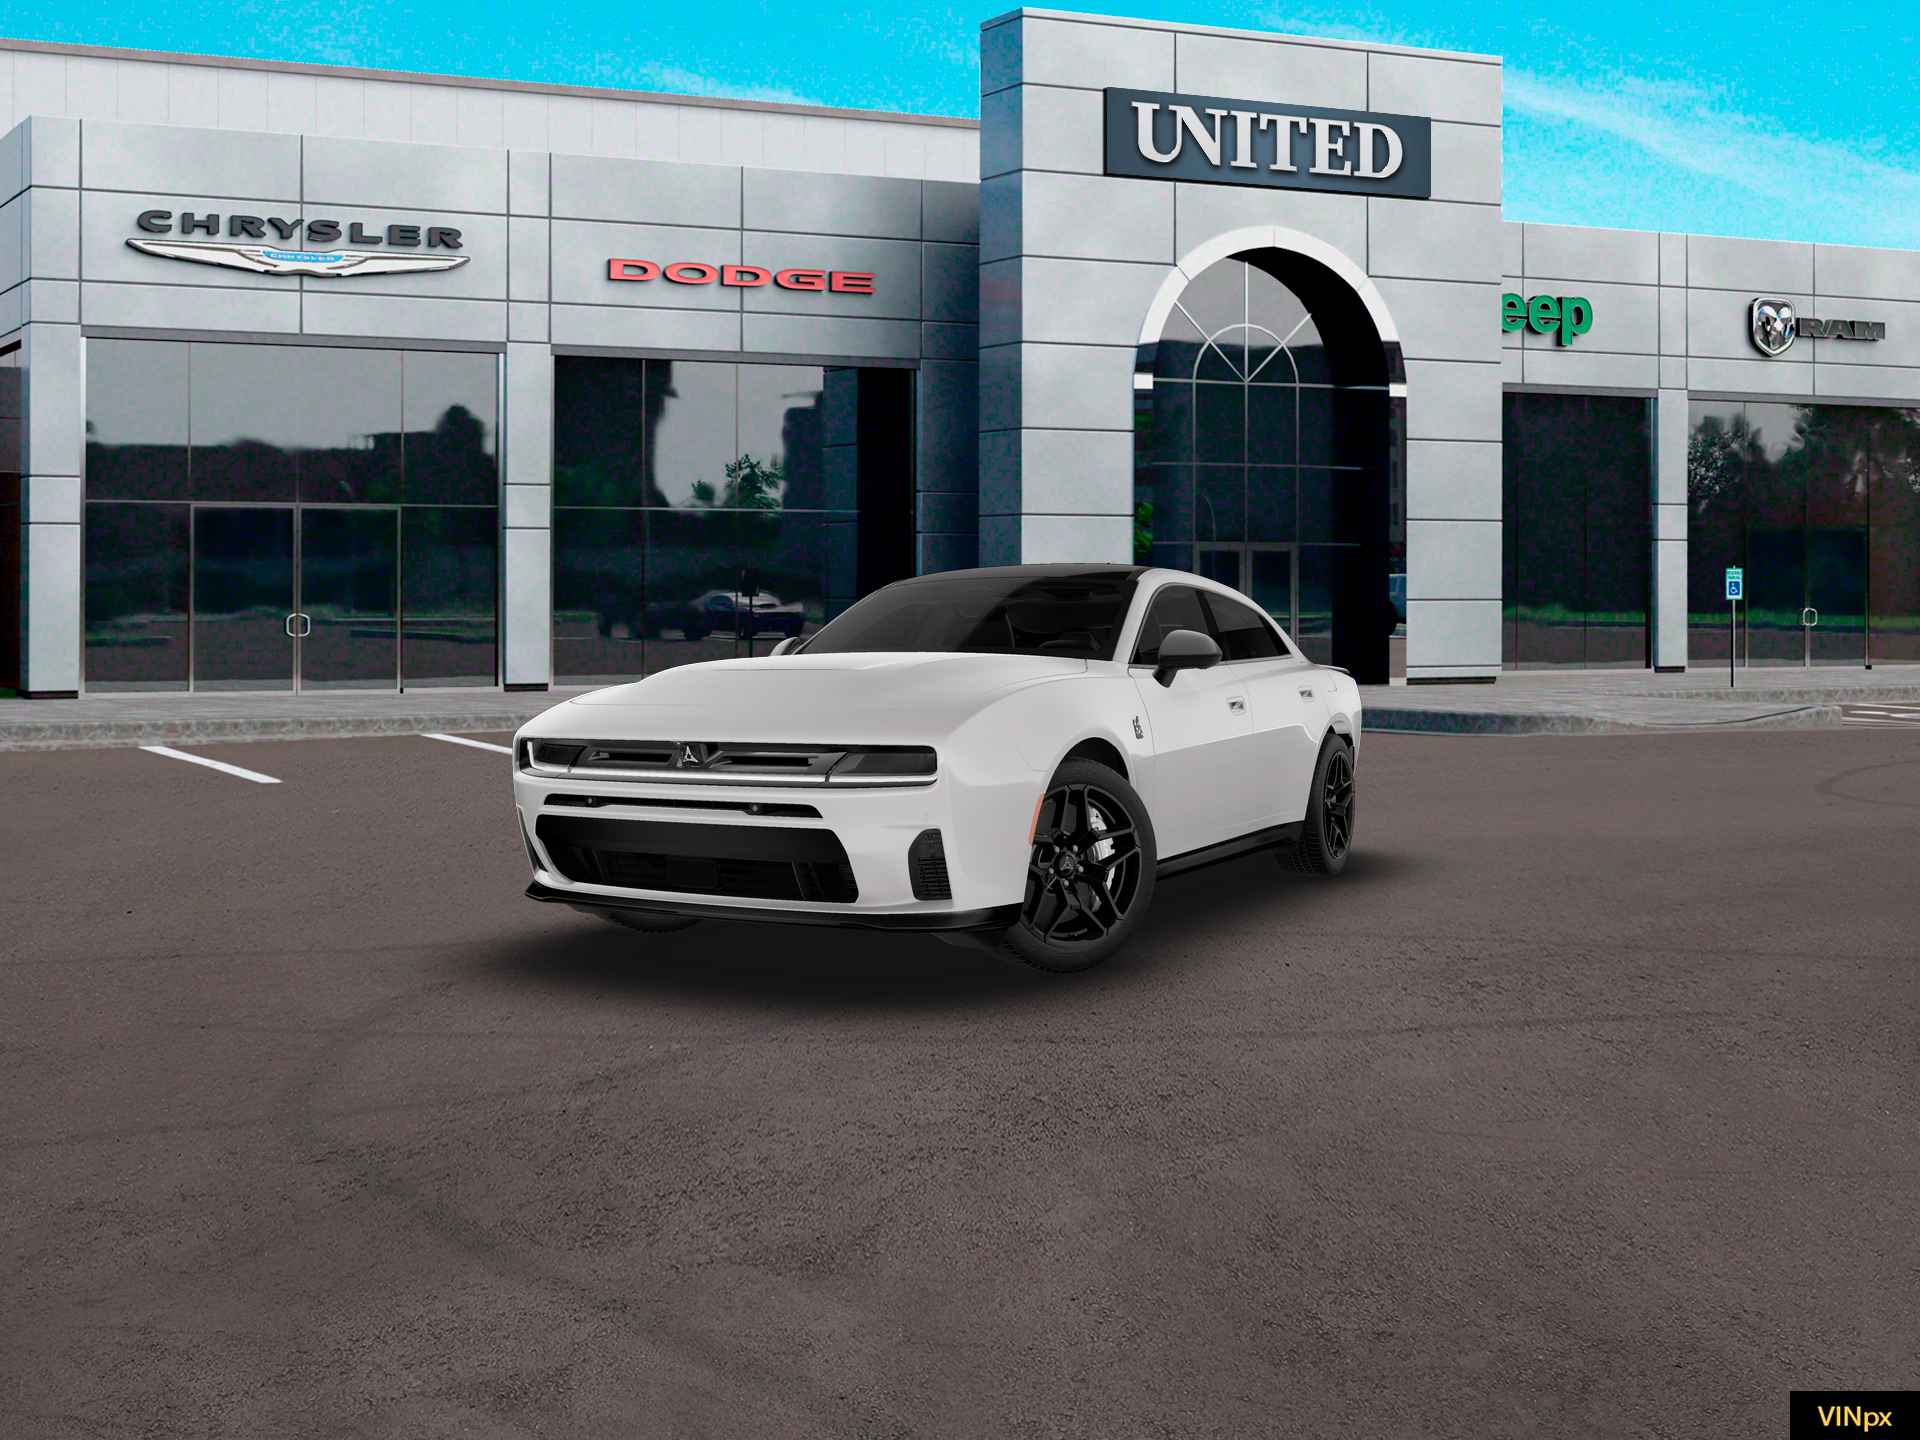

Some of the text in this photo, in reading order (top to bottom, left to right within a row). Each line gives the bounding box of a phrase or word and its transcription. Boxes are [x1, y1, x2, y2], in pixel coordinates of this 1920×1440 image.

[1131, 101, 1403, 179] UNITED
[137, 210, 463, 249] CHRYSLER
[607, 258, 876, 294] DODGE
[1501, 293, 1593, 346] eep
[1797, 317, 1886, 341] RAM
